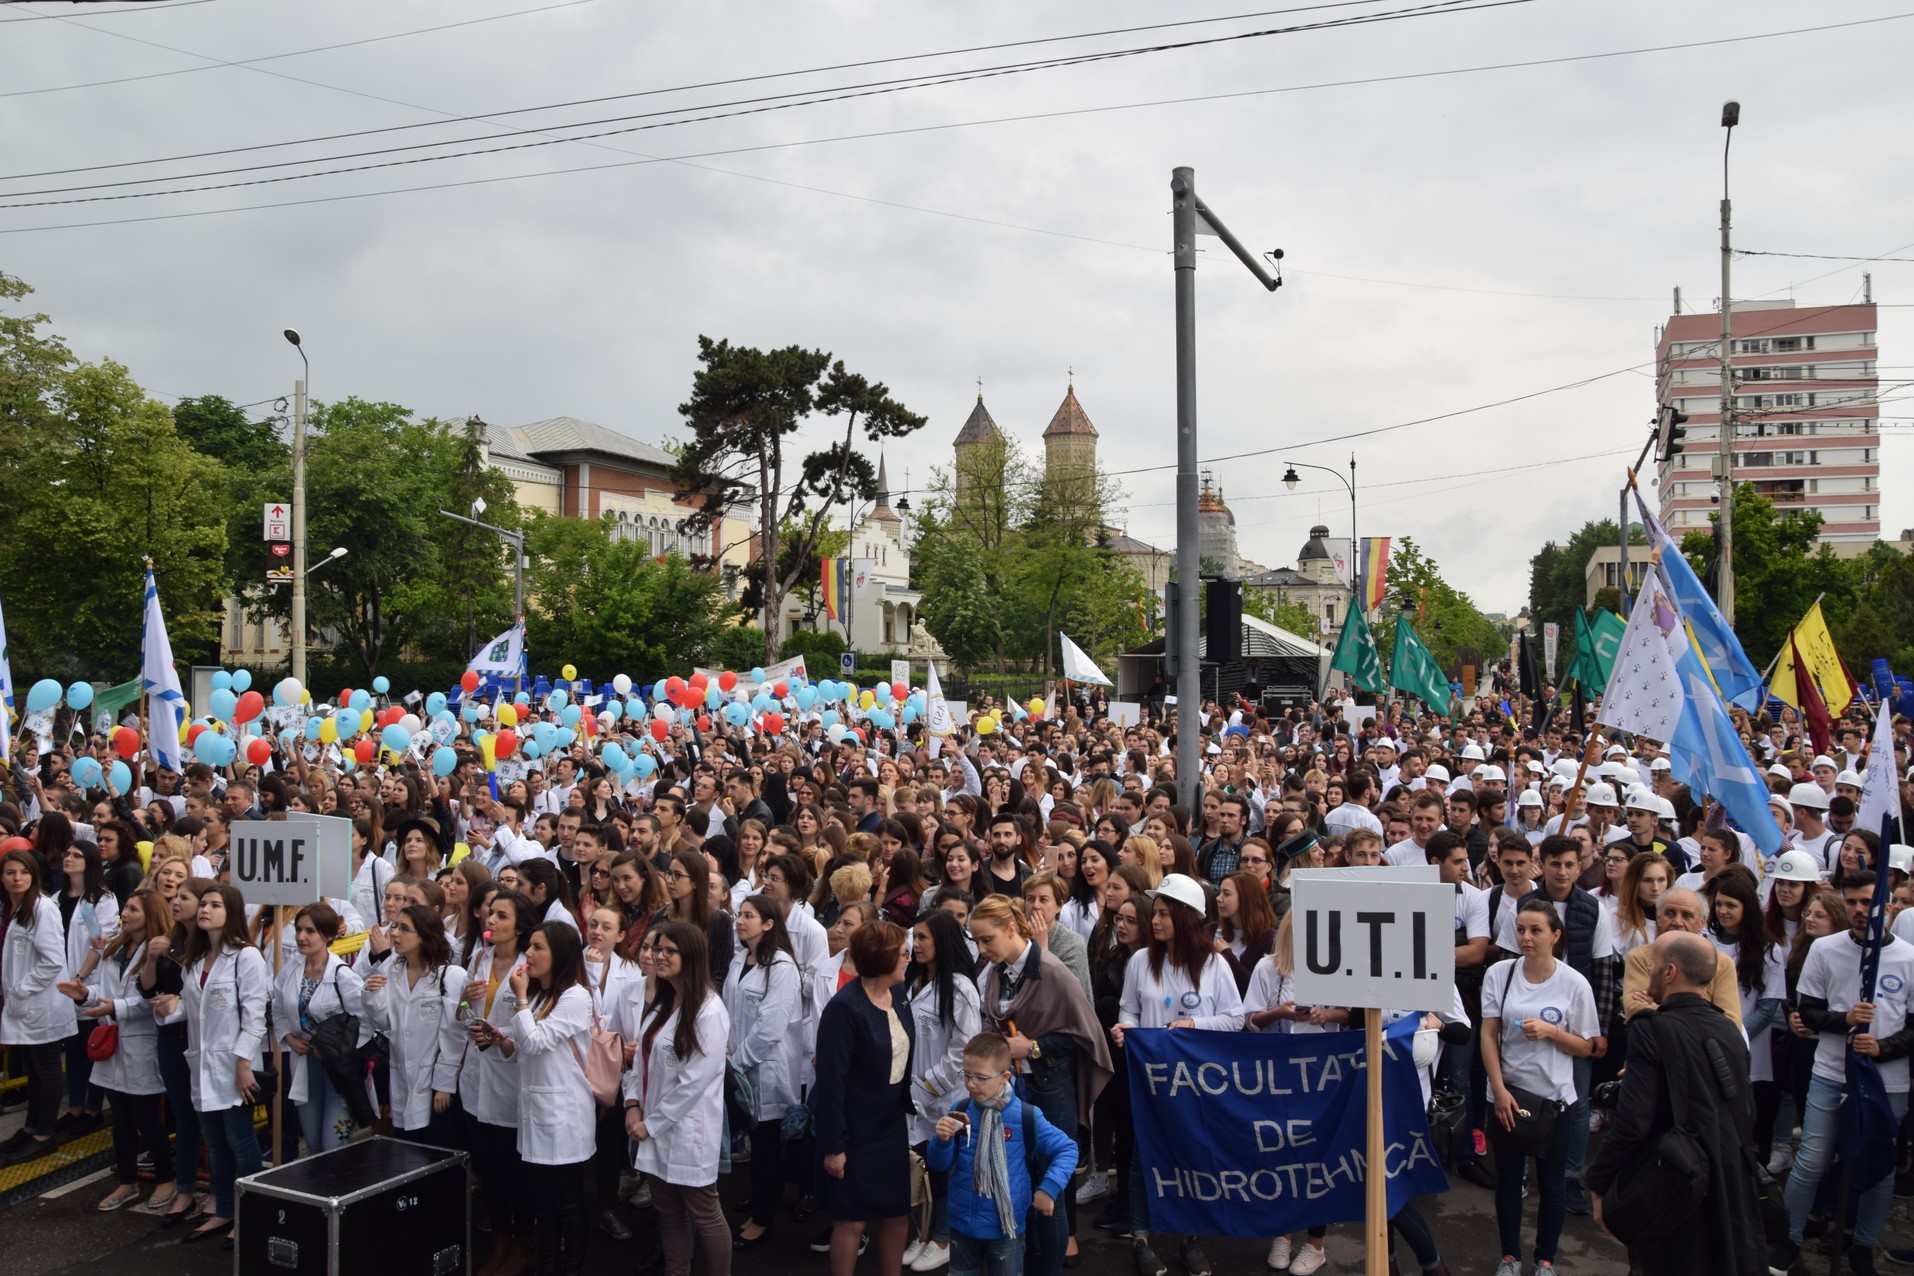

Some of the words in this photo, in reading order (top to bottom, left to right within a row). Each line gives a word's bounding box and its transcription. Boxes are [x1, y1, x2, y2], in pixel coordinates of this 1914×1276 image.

[237, 838, 308, 883] U.M.F.
[1306, 910, 1438, 980] U.T.I.
[1145, 1040, 1398, 1097] FACULTAA
[1253, 1120, 1317, 1152] DE
[1152, 1131, 1438, 1202] HIDROTEHNCĂ
[278, 1209, 286, 1225] 2
